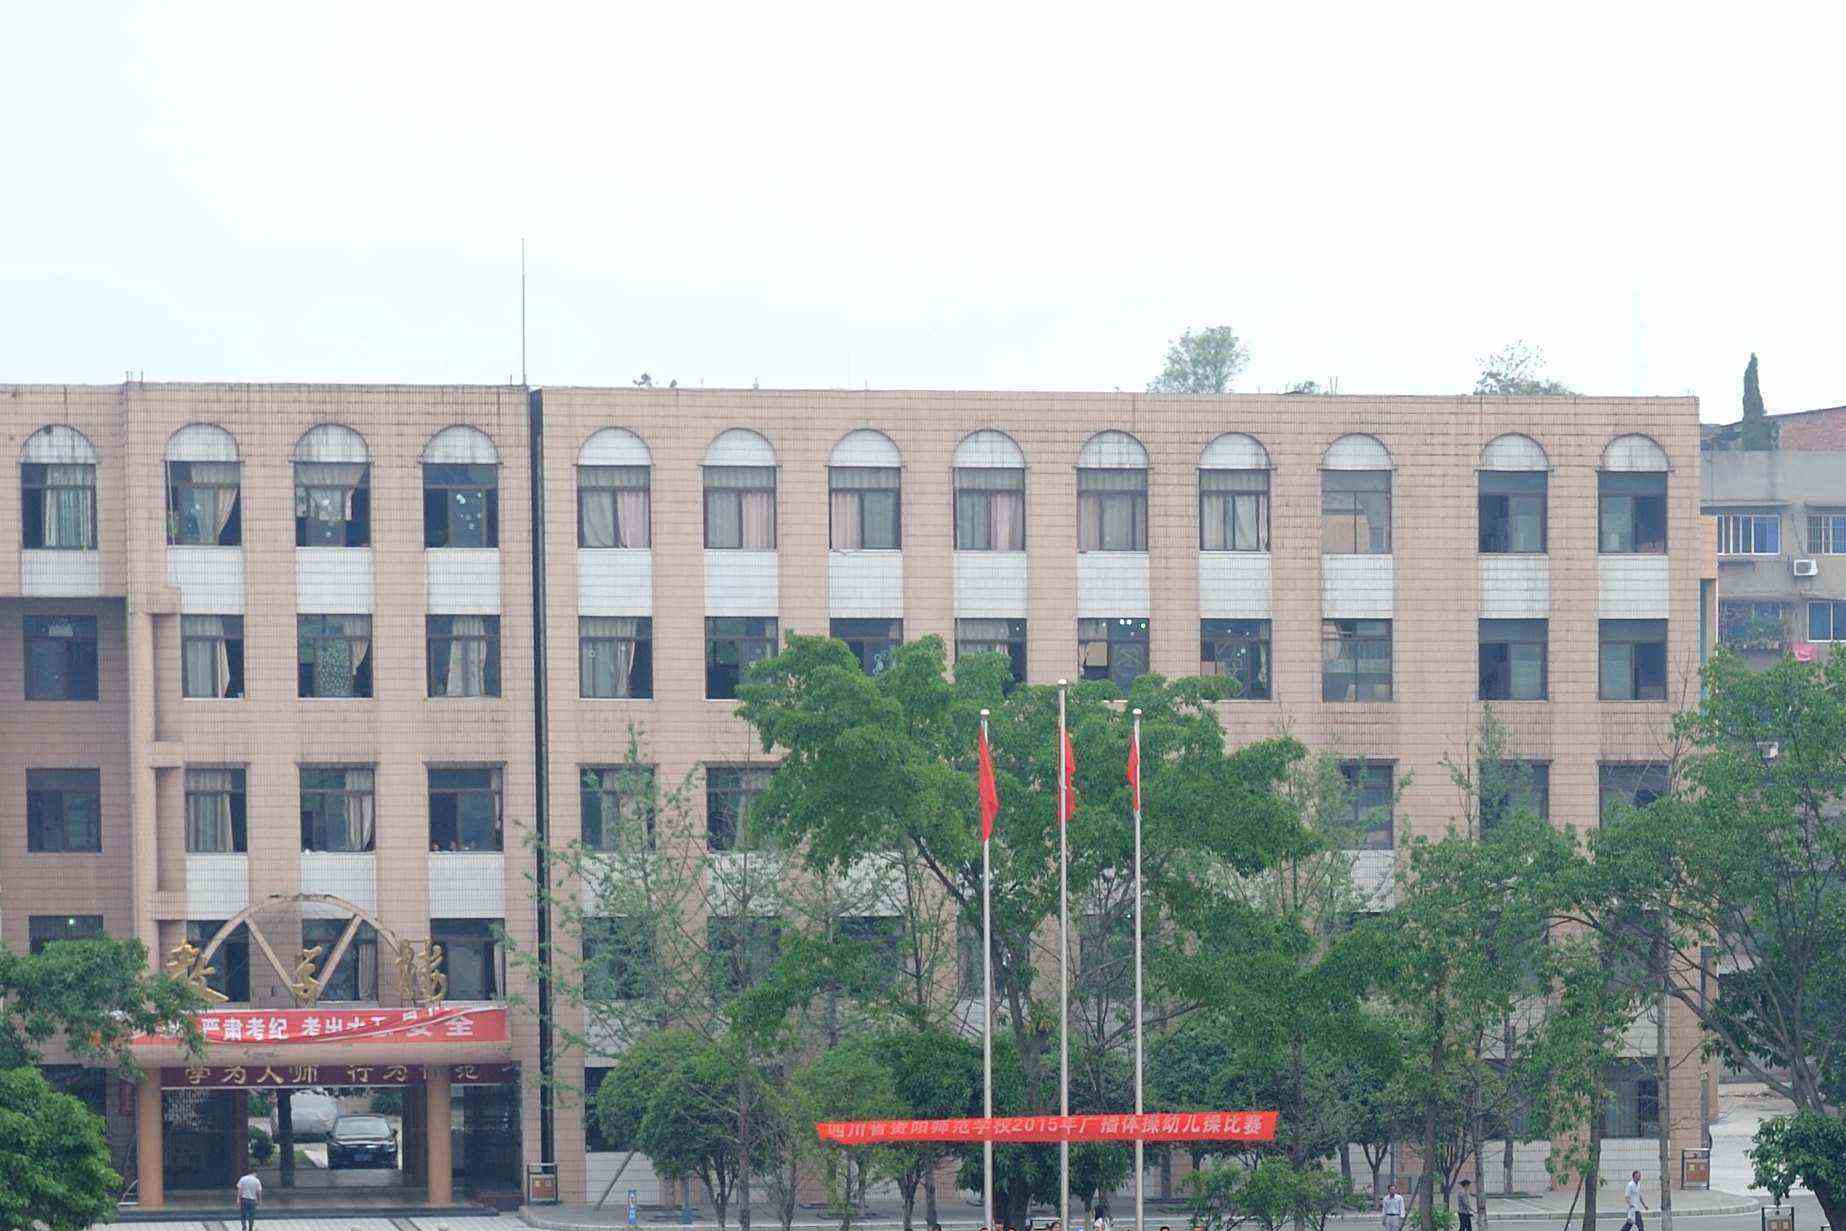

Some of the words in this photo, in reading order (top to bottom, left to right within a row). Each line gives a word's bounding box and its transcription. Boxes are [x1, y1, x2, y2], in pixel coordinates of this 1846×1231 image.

[200, 1016, 290, 1041] 严肃考纪
[185, 1064, 319, 1085] 学为人师
[347, 1064, 480, 1081] 行为范
